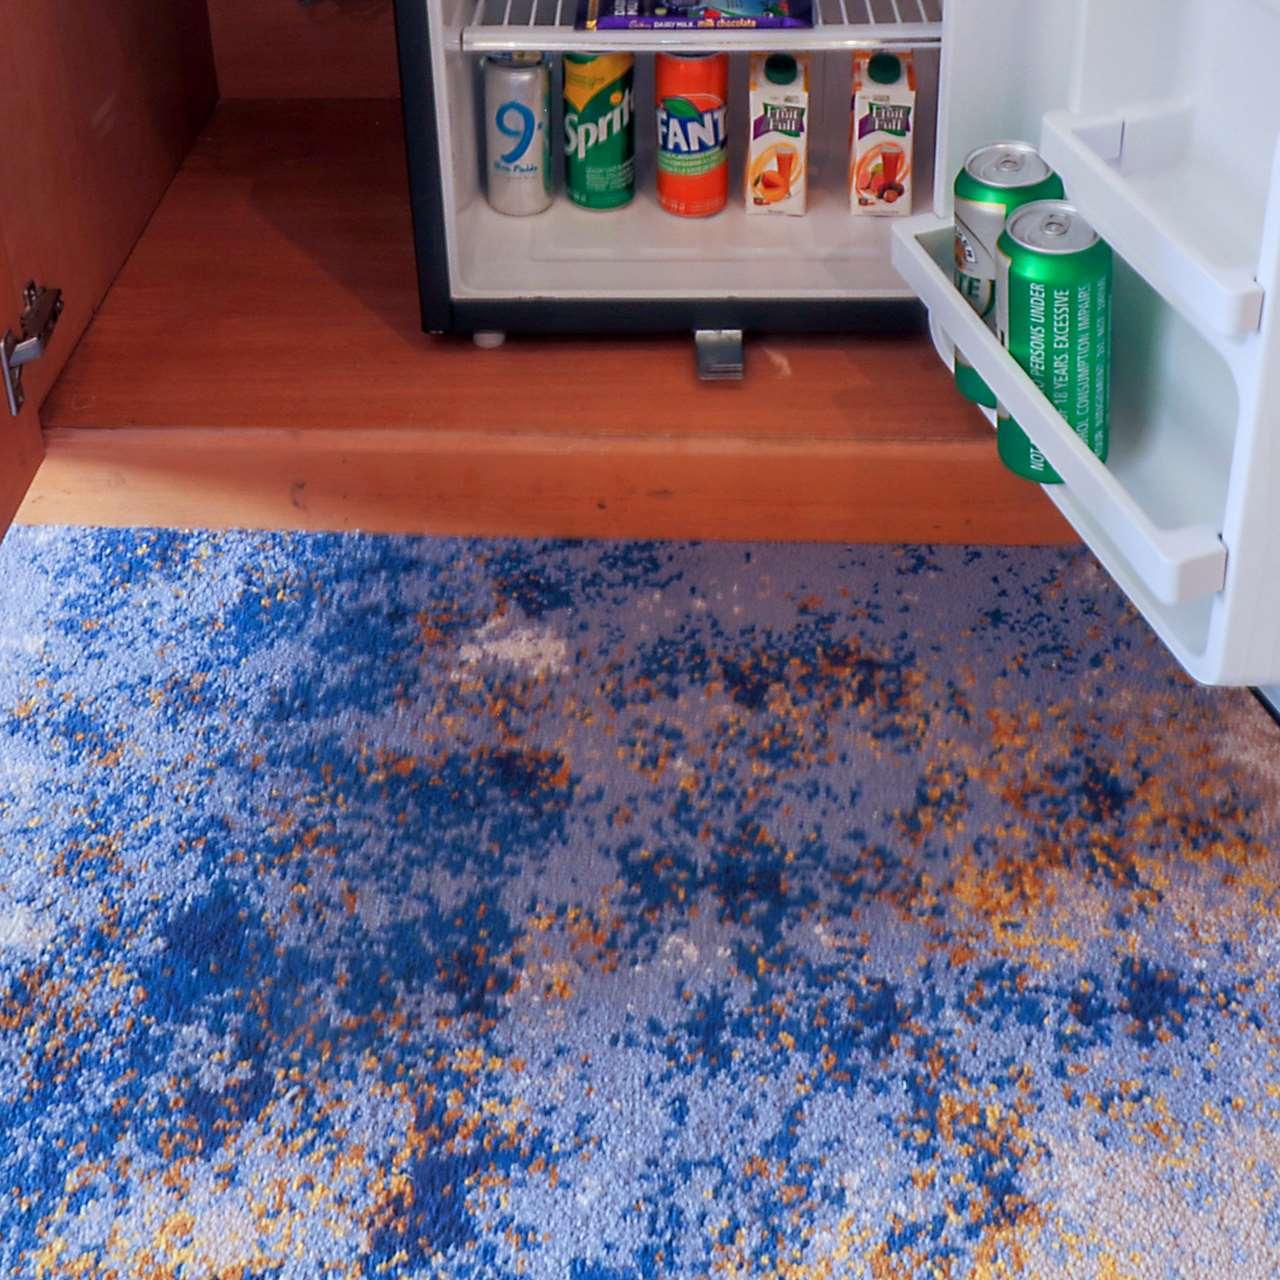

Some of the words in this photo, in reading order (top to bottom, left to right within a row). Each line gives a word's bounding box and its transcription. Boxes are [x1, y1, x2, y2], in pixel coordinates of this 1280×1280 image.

[654, 21, 676, 29] DAIRY
[716, 18, 757, 28] chocolate
[495, 100, 536, 164] 9
[1030, 282, 1046, 324] UNDER
[1053, 288, 1070, 349] EXCESSIVE
[1030, 325, 1046, 377] PERSONS
[1076, 333, 1090, 416] CONSUMPTION
[1030, 447, 1046, 472] NOT
